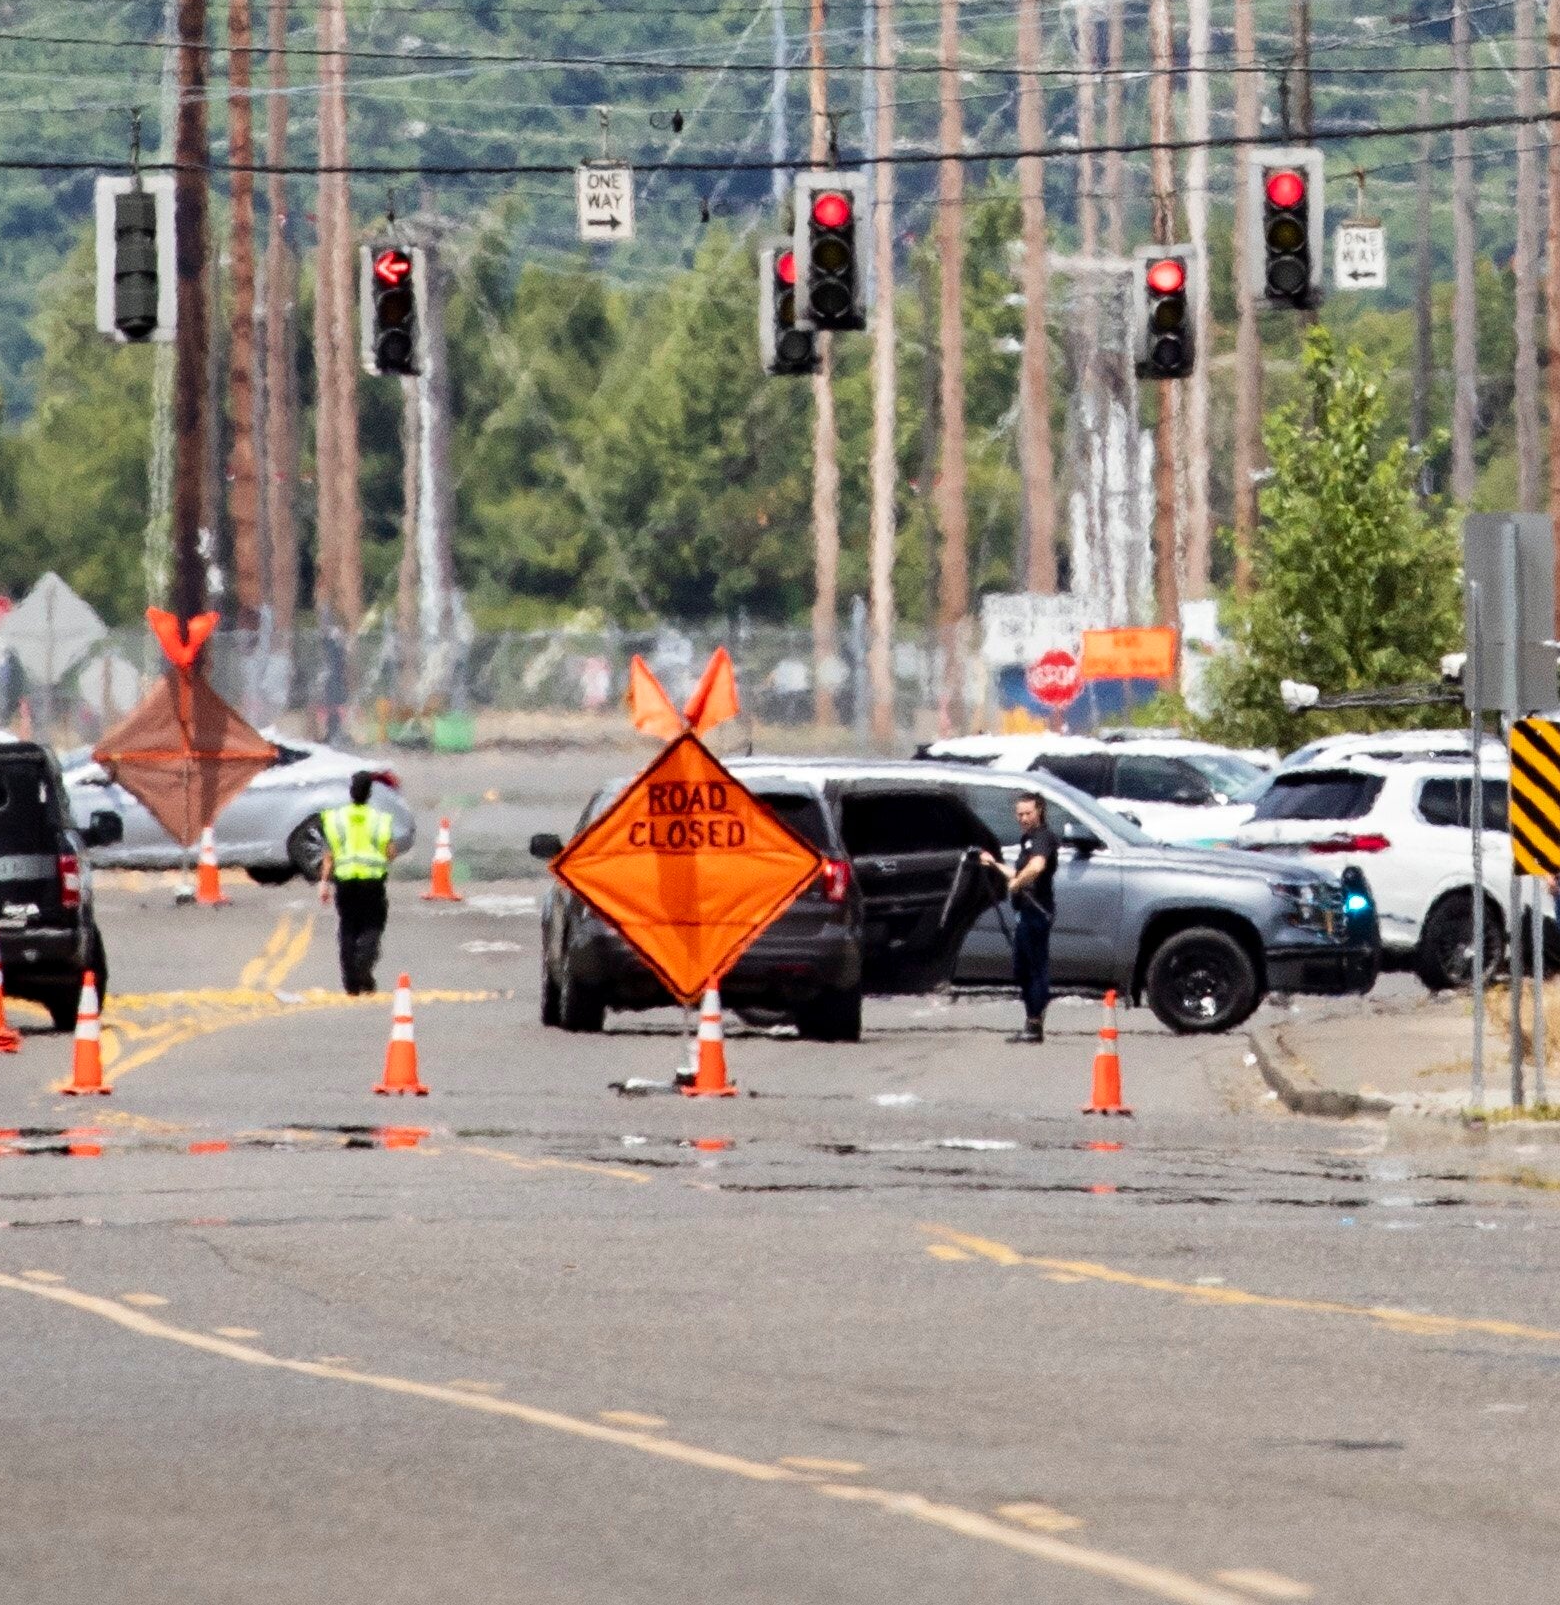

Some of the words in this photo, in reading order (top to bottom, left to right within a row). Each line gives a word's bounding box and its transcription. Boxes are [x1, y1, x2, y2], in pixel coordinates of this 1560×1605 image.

[587, 173, 622, 189] ONE
[586, 193, 622, 209] WAY
[1344, 231, 1379, 246] ONE
[1343, 248, 1378, 262] WAY
[648, 782, 728, 813] ROAD
[628, 819, 746, 849] CLOSED
